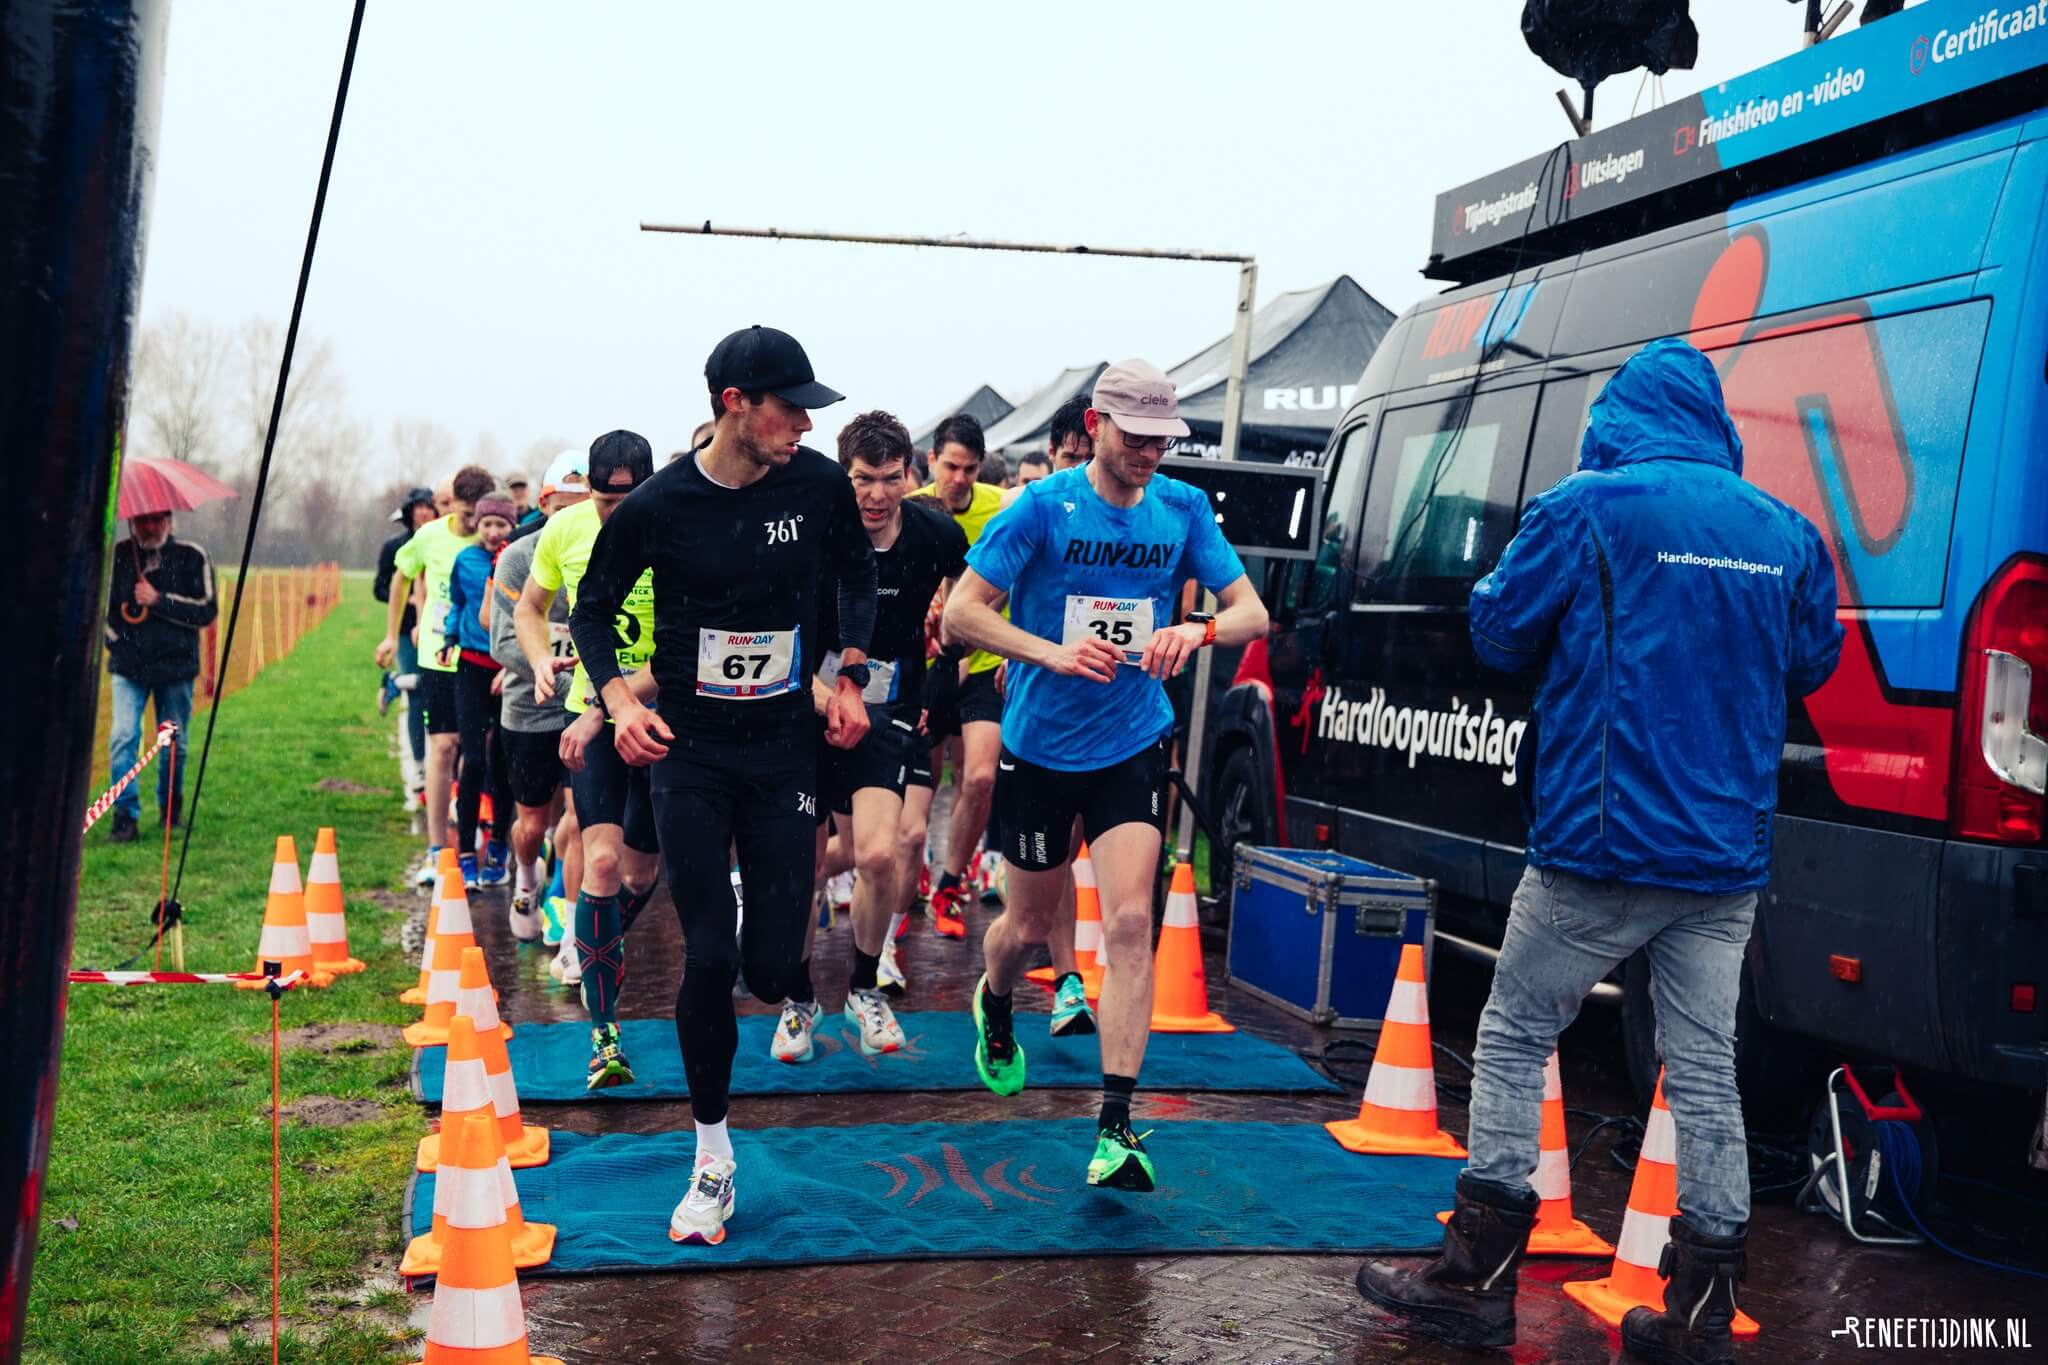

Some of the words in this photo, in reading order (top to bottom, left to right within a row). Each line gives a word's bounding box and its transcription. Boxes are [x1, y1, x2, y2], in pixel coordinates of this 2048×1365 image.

[1931, 0, 2047, 63] Certificaat
[1698, 98, 1779, 148] Finishfoto
[1780, 90, 1803, 118] en
[1806, 66, 1865, 106] -video
[1581, 148, 1644, 188] Uitslagen
[1140, 393, 1169, 407] ciele
[1657, 551, 1784, 577] Hardloopuitslagen.nl
[1088, 620, 1134, 646] 35
[722, 654, 772, 680] 67
